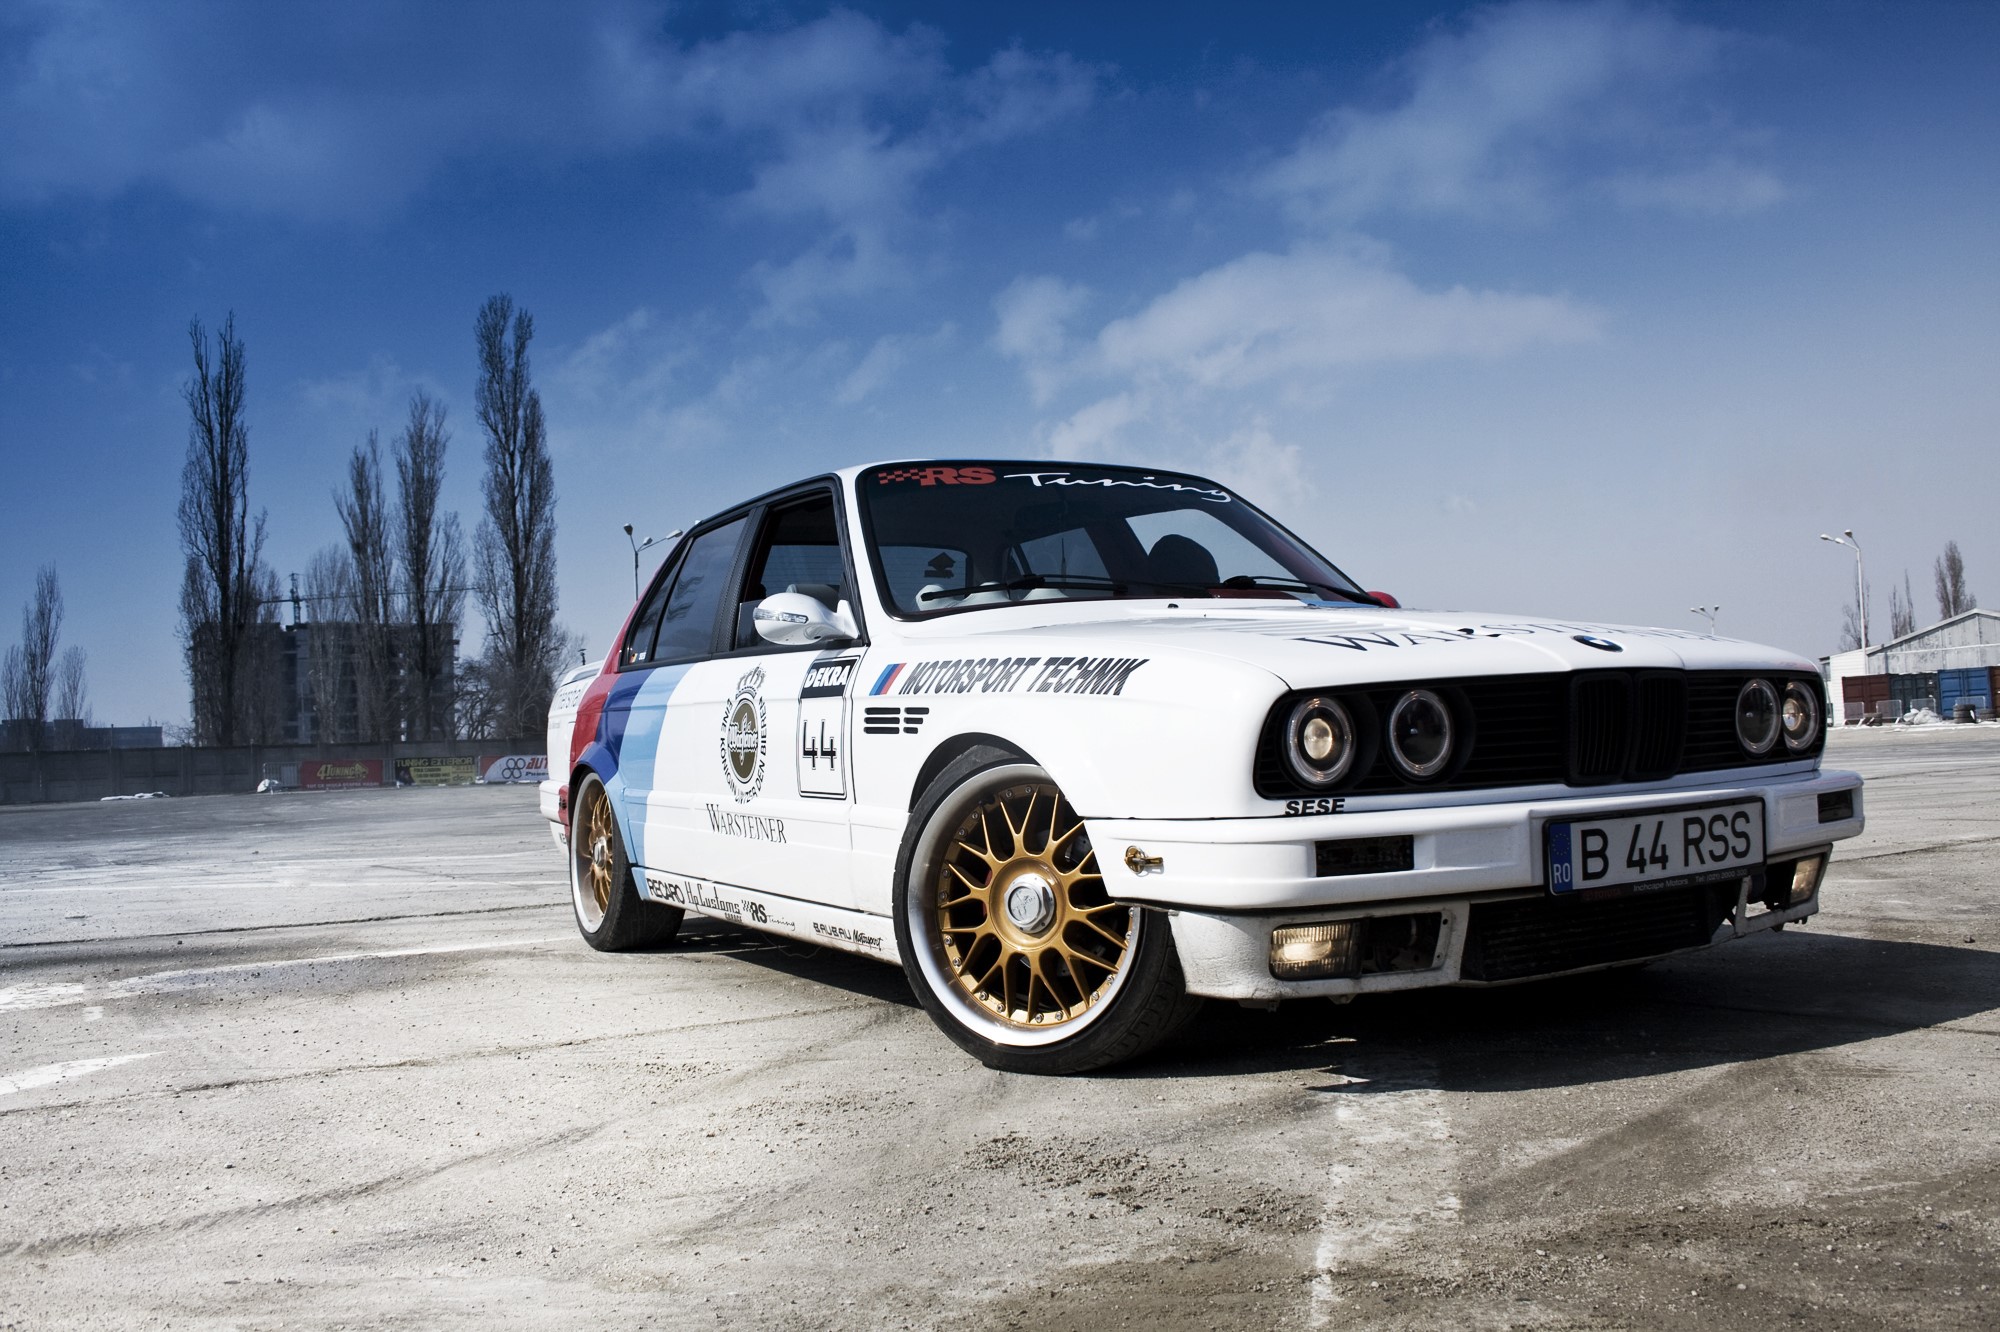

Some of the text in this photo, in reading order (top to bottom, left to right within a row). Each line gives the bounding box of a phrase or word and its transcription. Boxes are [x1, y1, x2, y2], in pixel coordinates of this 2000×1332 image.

[918, 467, 1232, 503] RS Tuning
[804, 665, 851, 688] DEKRA
[900, 657, 1150, 696] MOTORSPORT TECHNIK
[720, 698, 733, 732] EINE
[755, 762, 765, 792] DEN
[802, 719, 838, 771] 44
[396, 757, 474, 767] TUNING EXTERIOR
[1285, 798, 1345, 817] SESE
[706, 803, 787, 844] WARSTEINER
[1580, 810, 1751, 881] B 44 RSS
[1553, 863, 1571, 884] RO
[1633, 880, 1664, 892] Inchcape
[1665, 878, 1689, 888] Motors
[646, 878, 685, 904] RECARO
[750, 902, 796, 932] RS Tuning
[813, 922, 852, 940] BAUBAU
